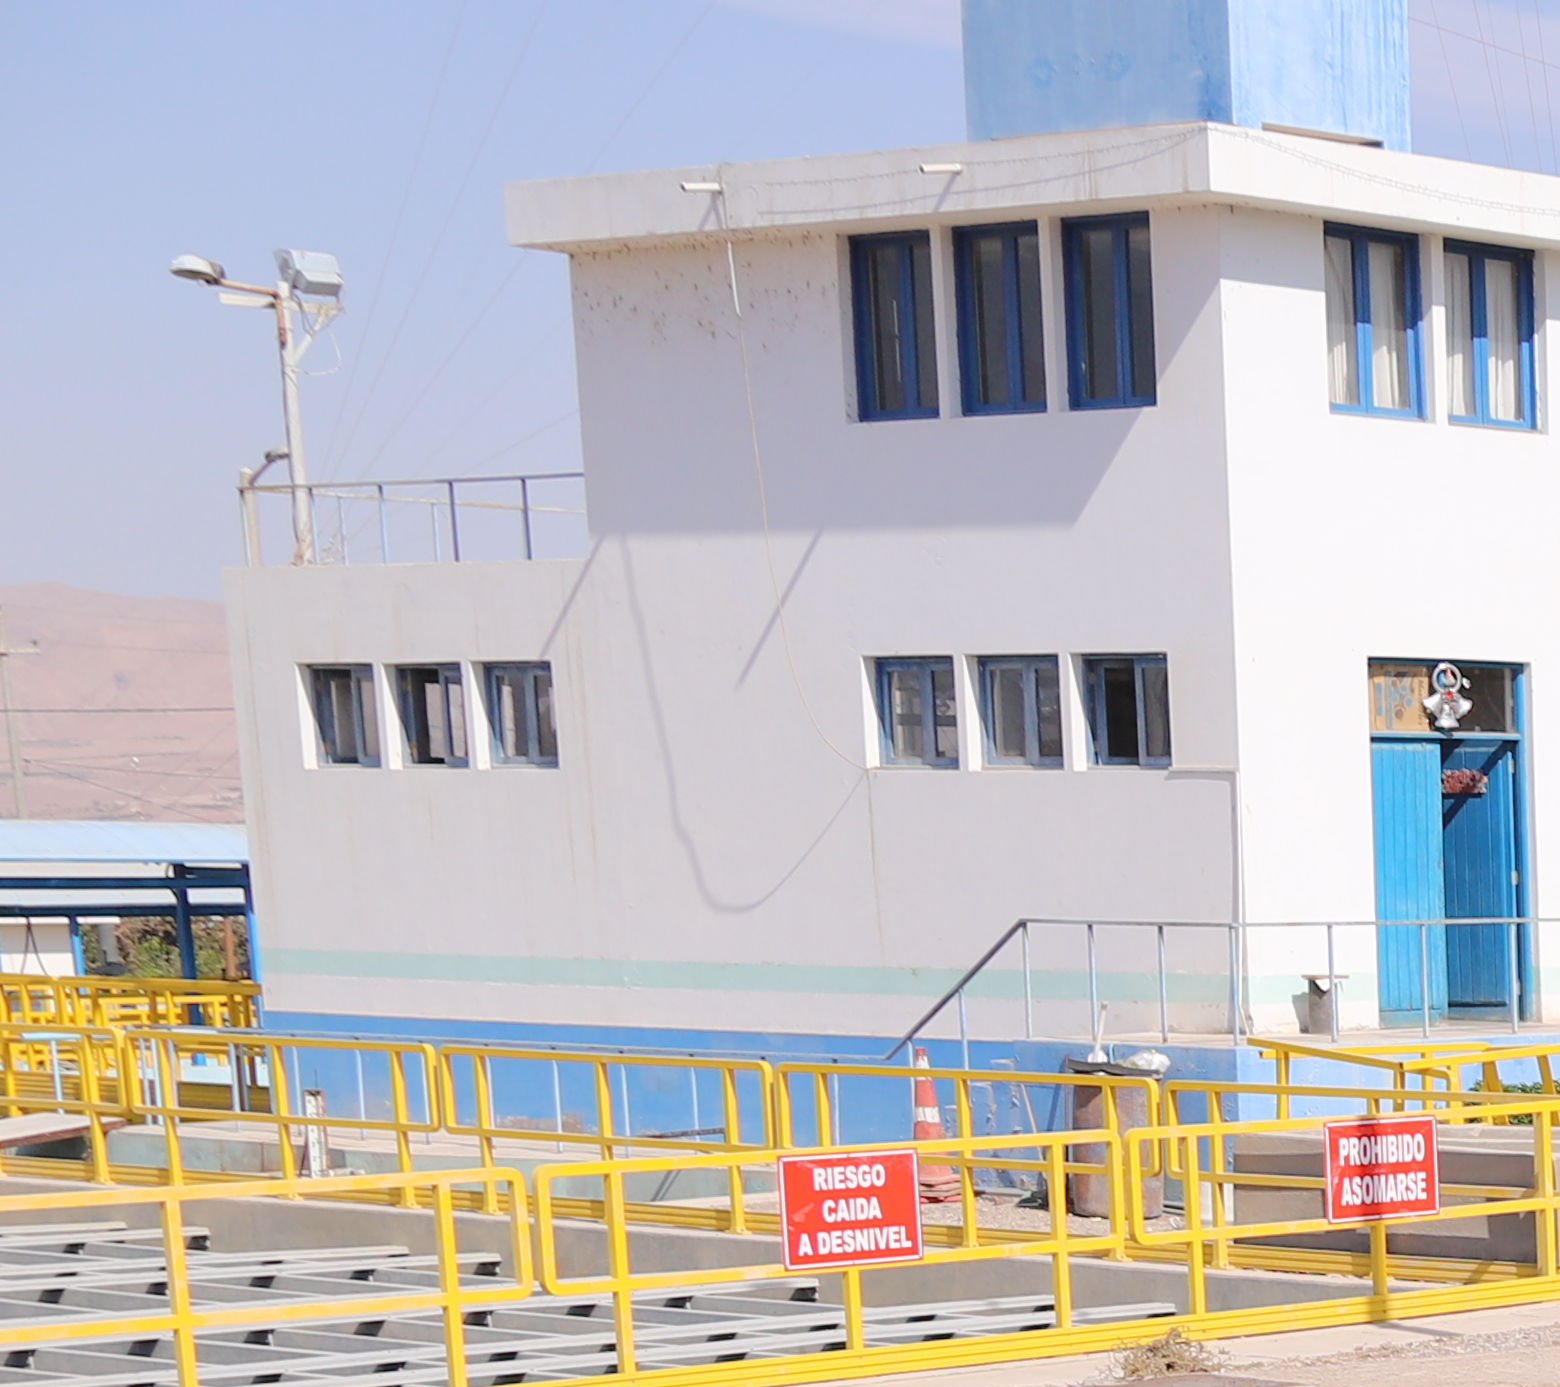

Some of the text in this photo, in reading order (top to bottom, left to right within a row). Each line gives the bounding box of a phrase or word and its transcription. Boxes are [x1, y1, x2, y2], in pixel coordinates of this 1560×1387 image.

[1338, 1132, 1426, 1167] PROHIBIDO
[813, 1163, 886, 1191] RIESGO
[1341, 1171, 1428, 1207] ASOMARSE
[822, 1196, 883, 1223] CAIDA
[798, 1225, 913, 1257] A DESNIVEL
